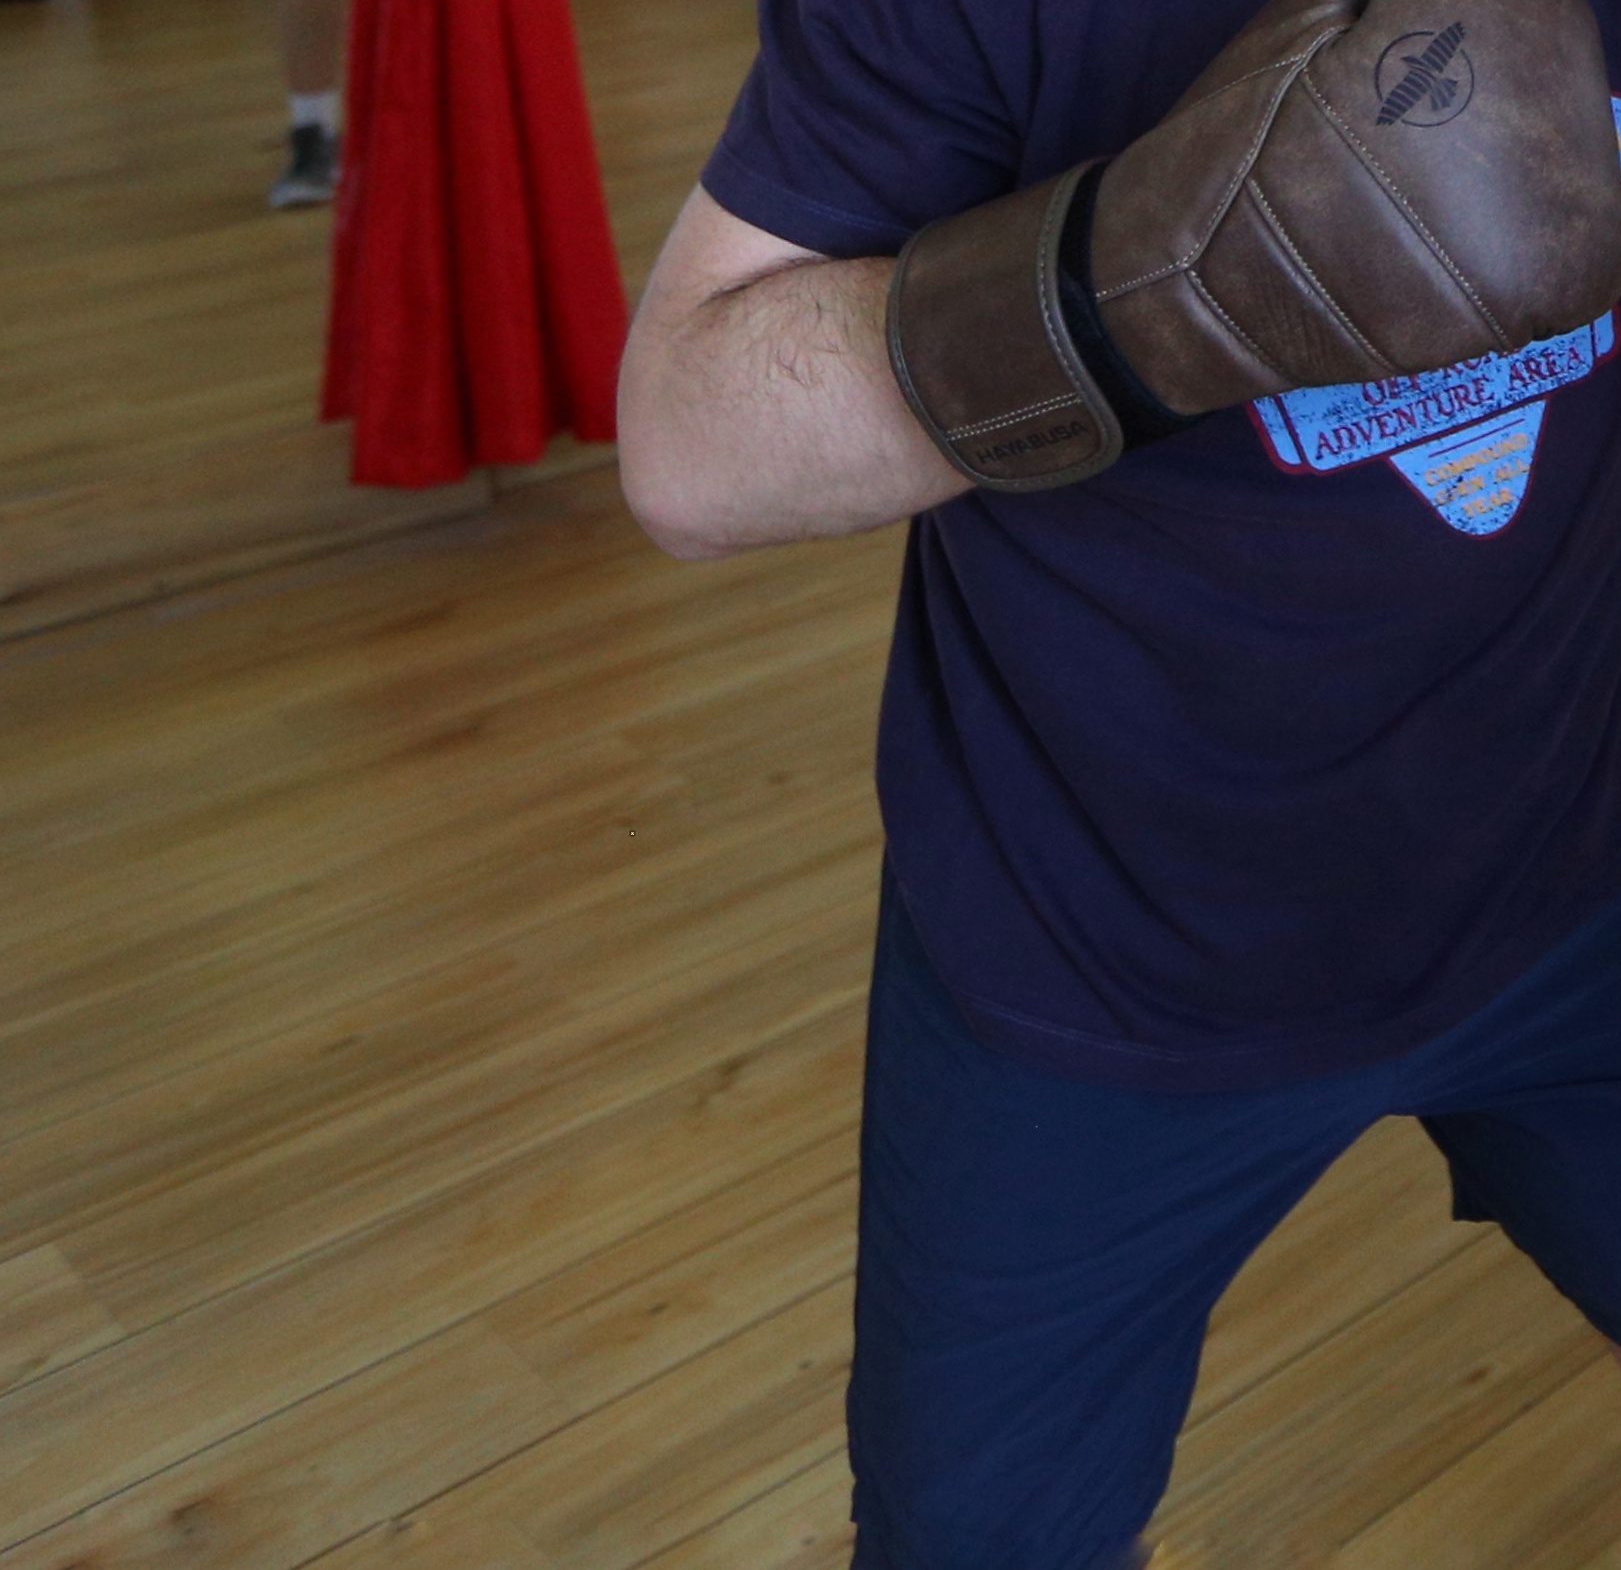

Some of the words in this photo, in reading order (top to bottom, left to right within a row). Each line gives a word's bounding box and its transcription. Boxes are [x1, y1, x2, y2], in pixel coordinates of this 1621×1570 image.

[1314, 374, 1496, 460] ADVENTURE
[1507, 345, 1586, 391] AREA
[976, 420, 1088, 464] HAYABUSA
[1496, 457, 1531, 480] ALL
[1461, 488, 1515, 519] YEAR
